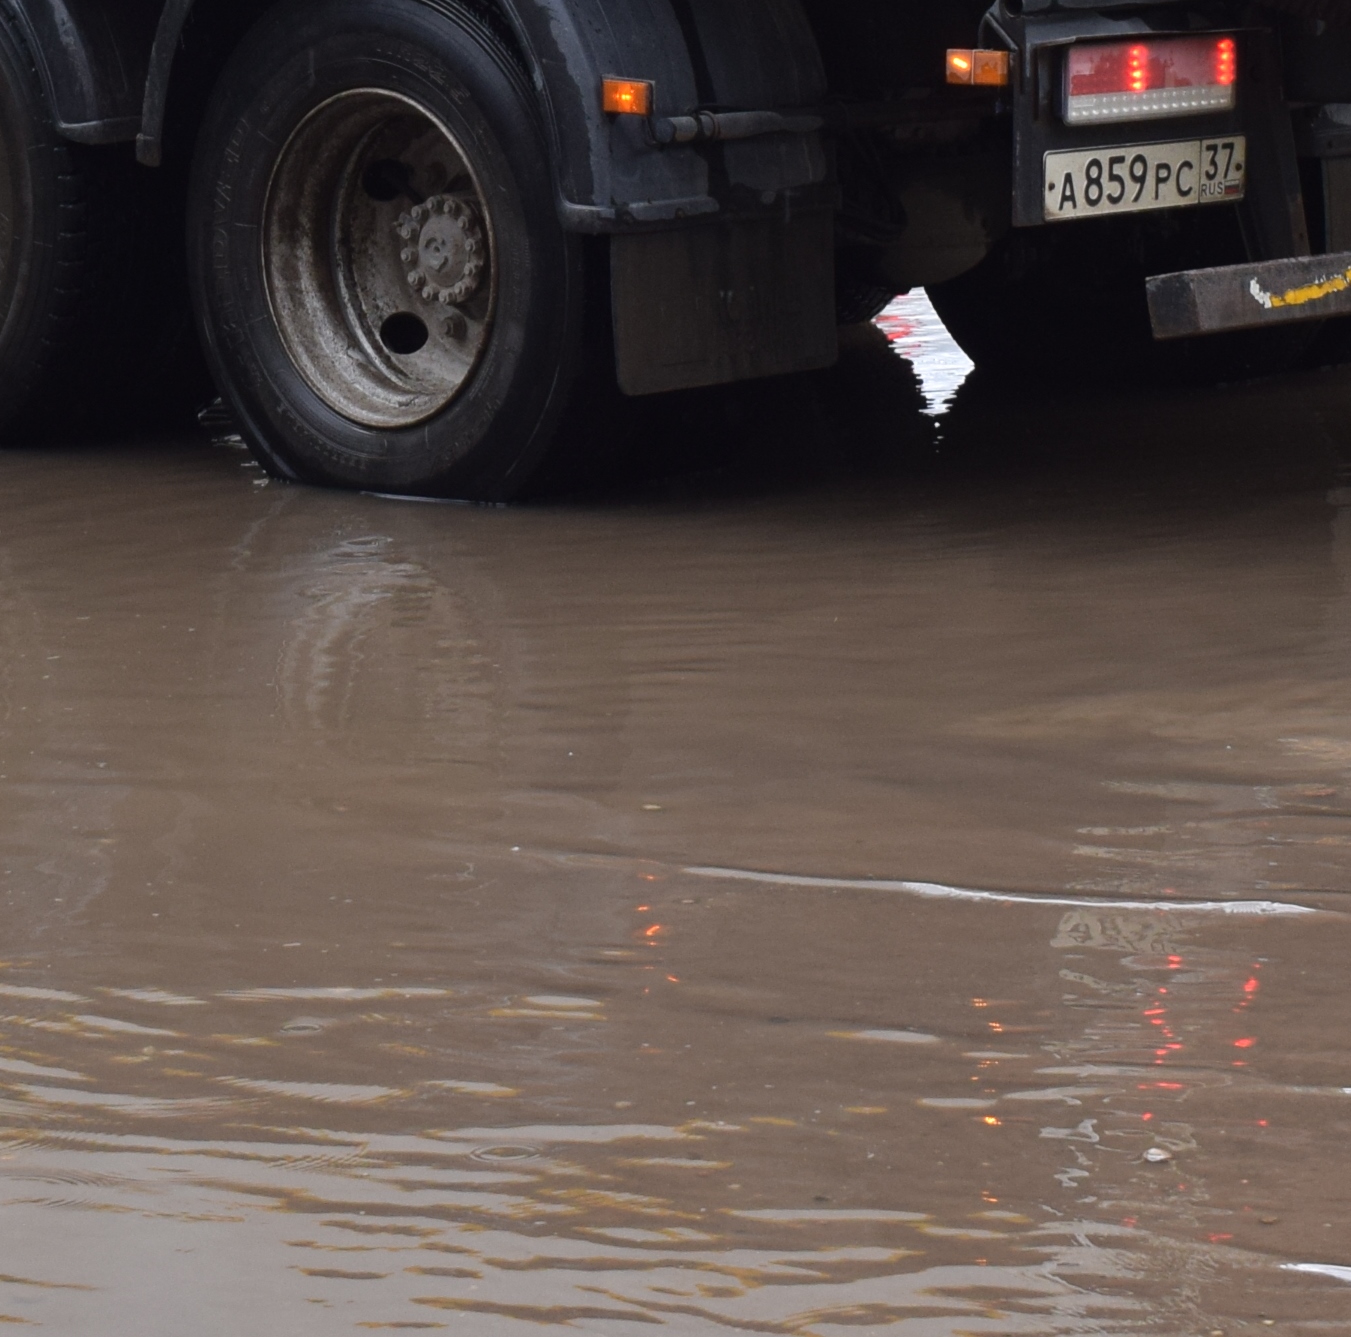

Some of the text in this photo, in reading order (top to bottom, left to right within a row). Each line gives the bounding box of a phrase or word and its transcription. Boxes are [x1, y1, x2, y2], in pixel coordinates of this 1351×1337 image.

[1058, 142, 1235, 211] А859РС 37
[1200, 181, 1224, 197] RUS
